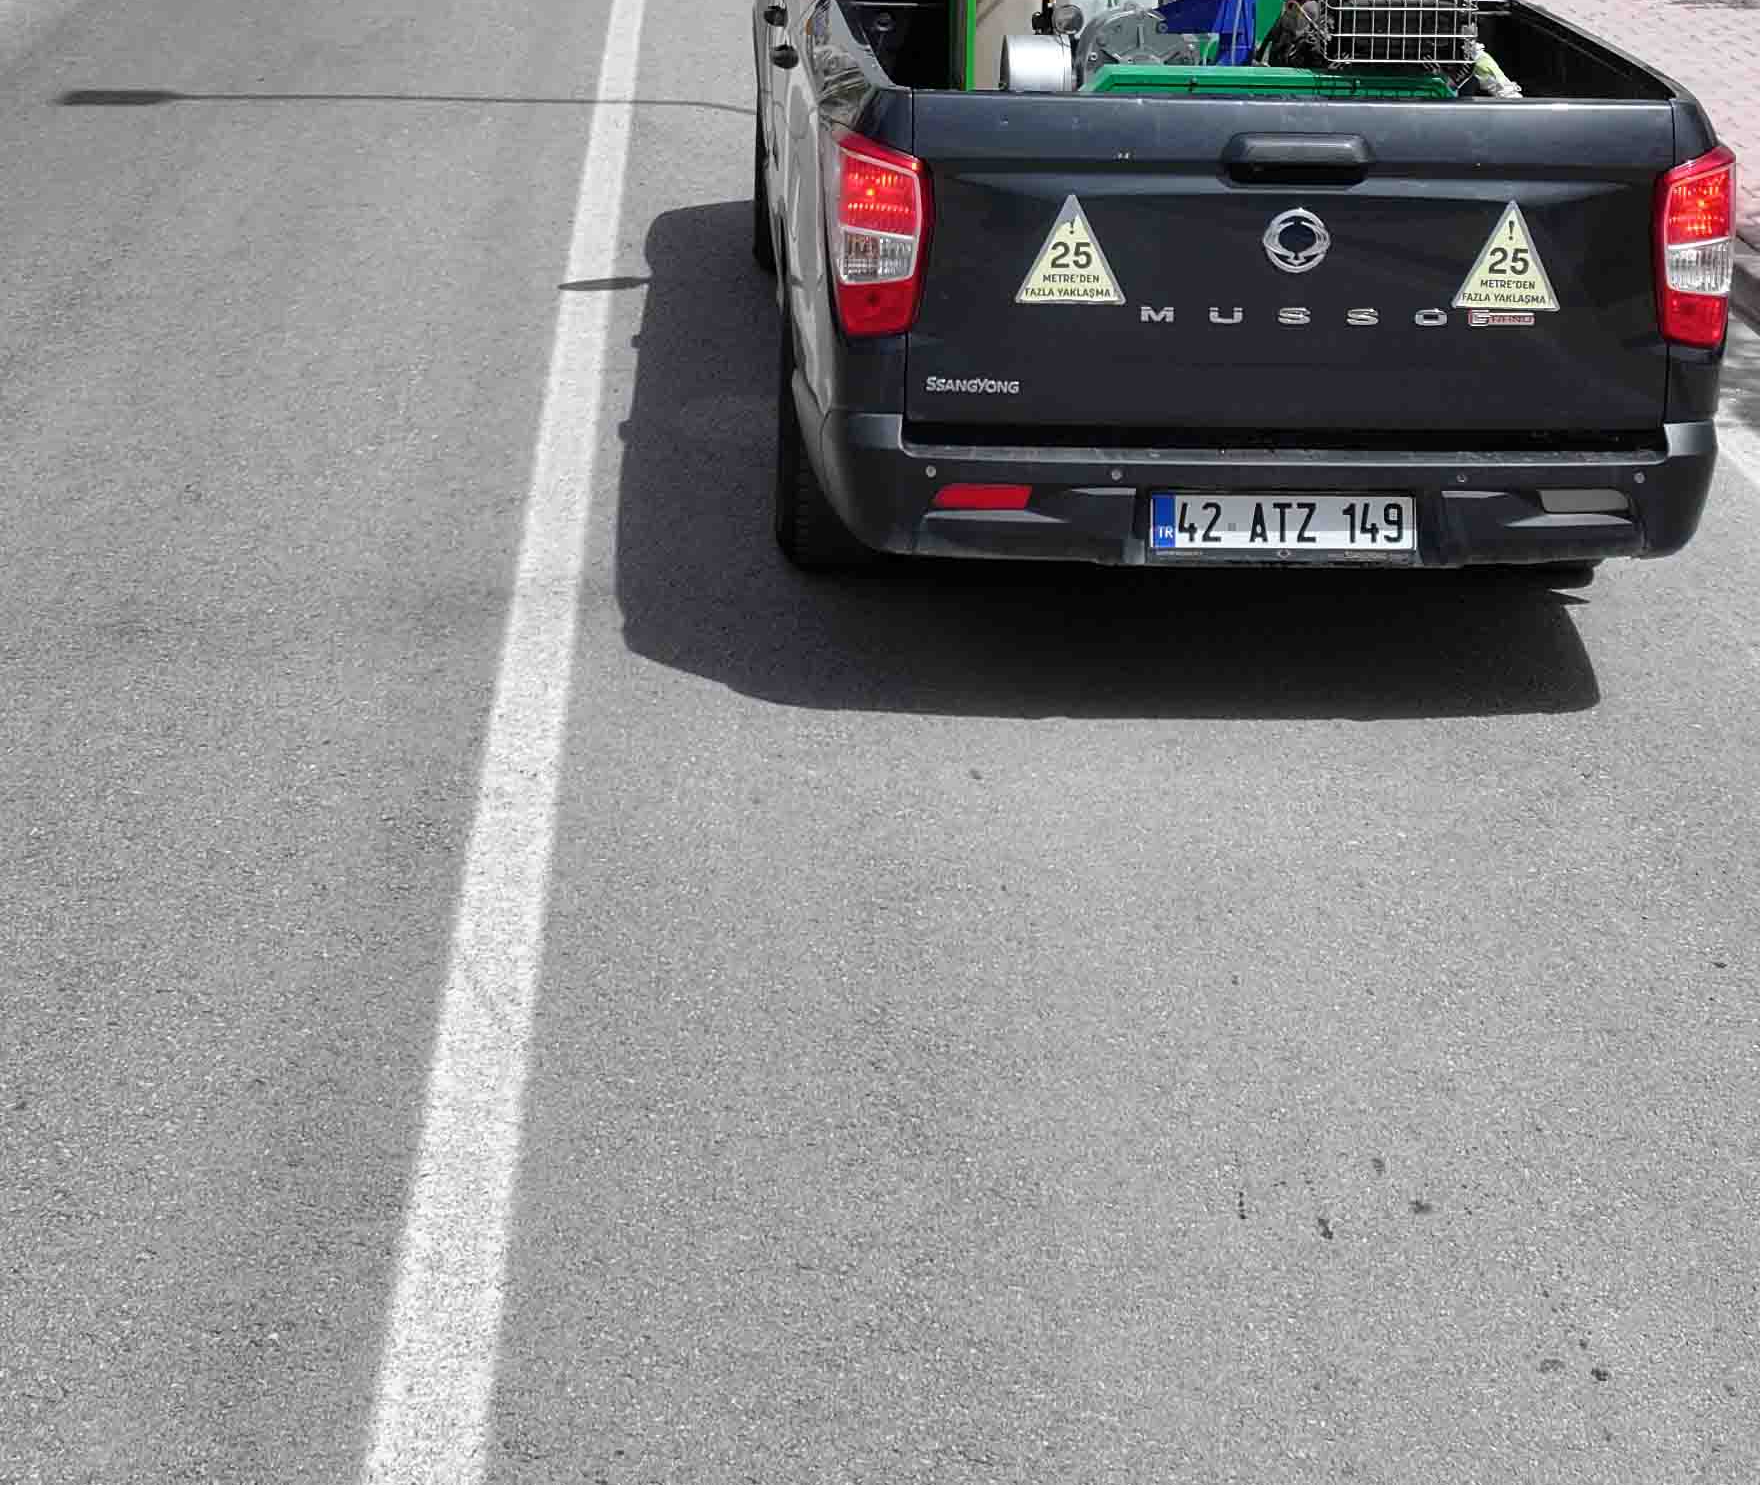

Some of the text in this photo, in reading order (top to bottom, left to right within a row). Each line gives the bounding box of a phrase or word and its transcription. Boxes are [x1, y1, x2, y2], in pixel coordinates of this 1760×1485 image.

[1050, 241, 1093, 269] 25
[1488, 247, 1530, 276] 25
[1042, 274, 1100, 284] METRE'DEN
[1480, 279, 1536, 290] METRE'DEN
[1025, 287, 1112, 299] FAZLA YAKLAŞMA
[1461, 292, 1546, 305] FAZLA YAKLAŞMA
[1141, 306, 1448, 326] MUSSO
[1158, 502, 1404, 544] TR 42 ATZ 149
